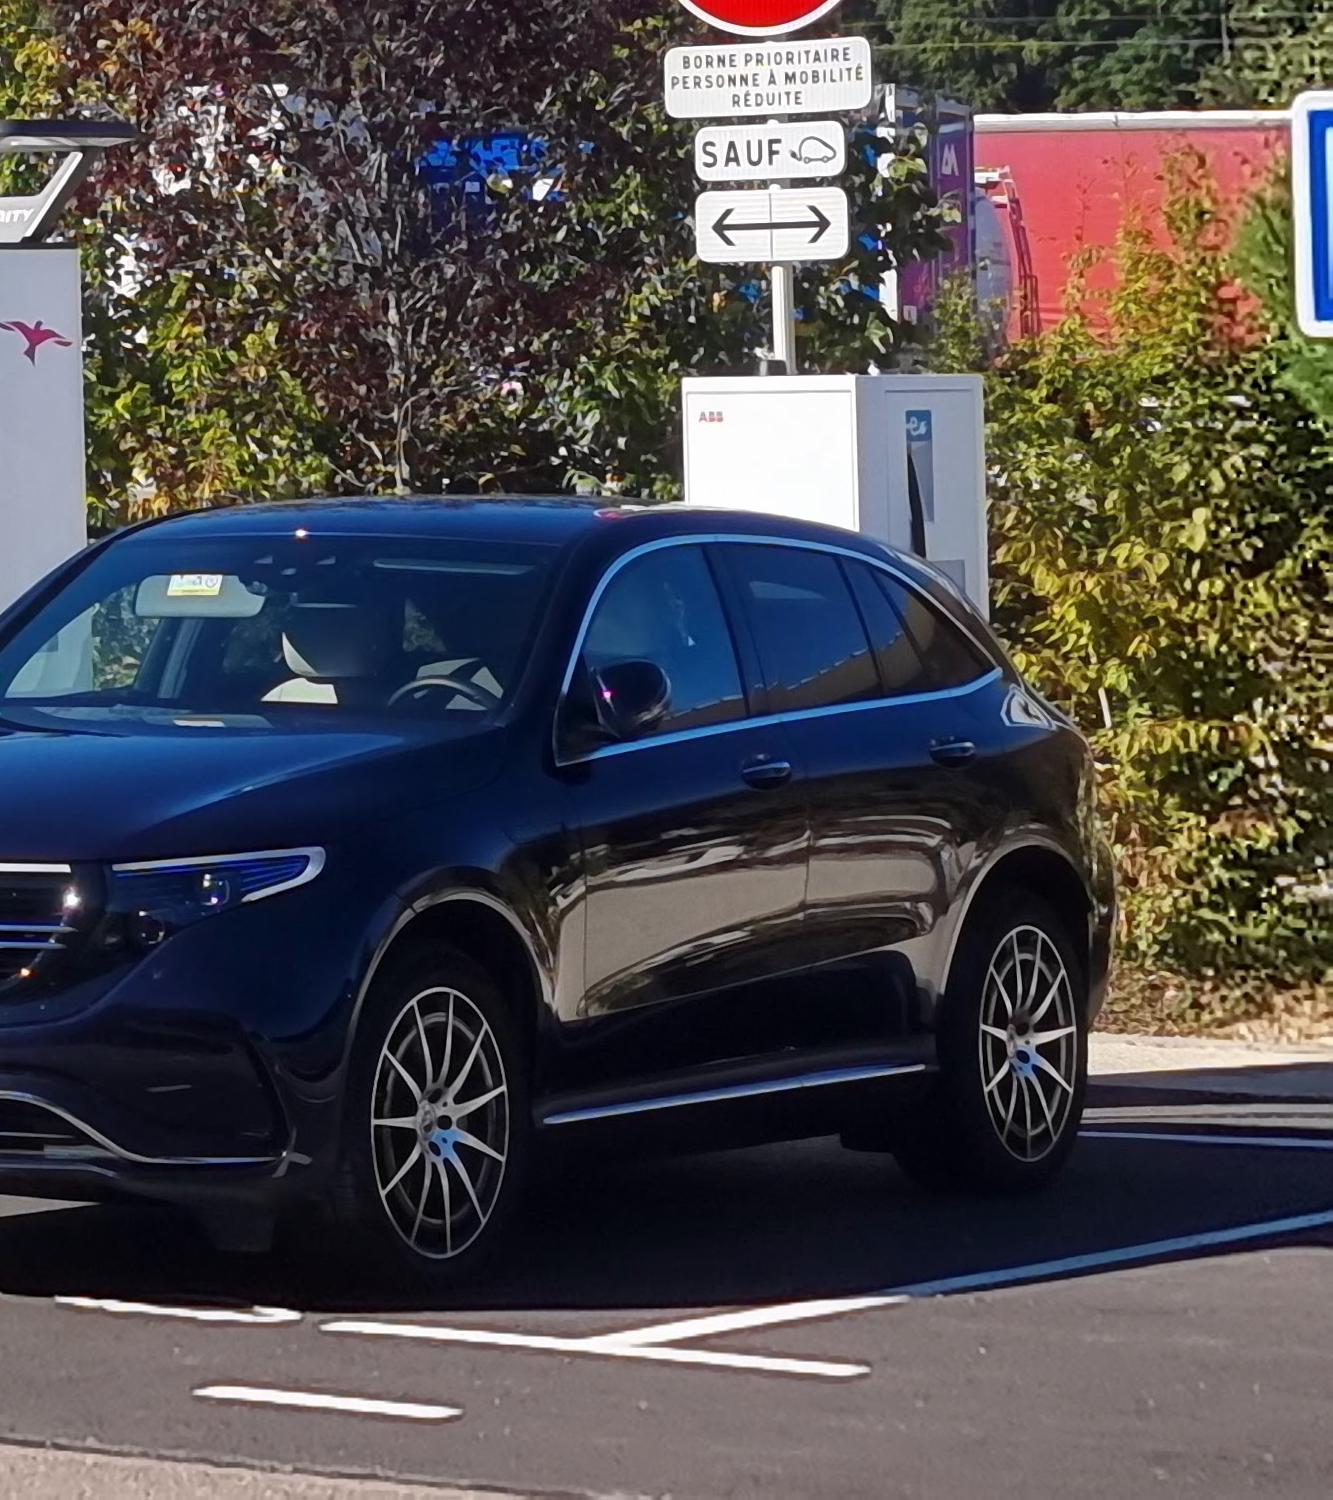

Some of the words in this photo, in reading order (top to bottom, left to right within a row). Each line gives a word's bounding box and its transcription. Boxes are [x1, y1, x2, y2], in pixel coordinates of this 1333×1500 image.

[683, 53, 737, 70] BORNE
[744, 47, 851, 67] PRIORITAIRE
[671, 72, 760, 90] PERSONNE
[767, 69, 777, 86] À
[784, 63, 864, 86] MOBILITÉ
[732, 90, 803, 108] RÉDUITE
[701, 138, 782, 168] SAUF
[698, 411, 724, 423] ABB
